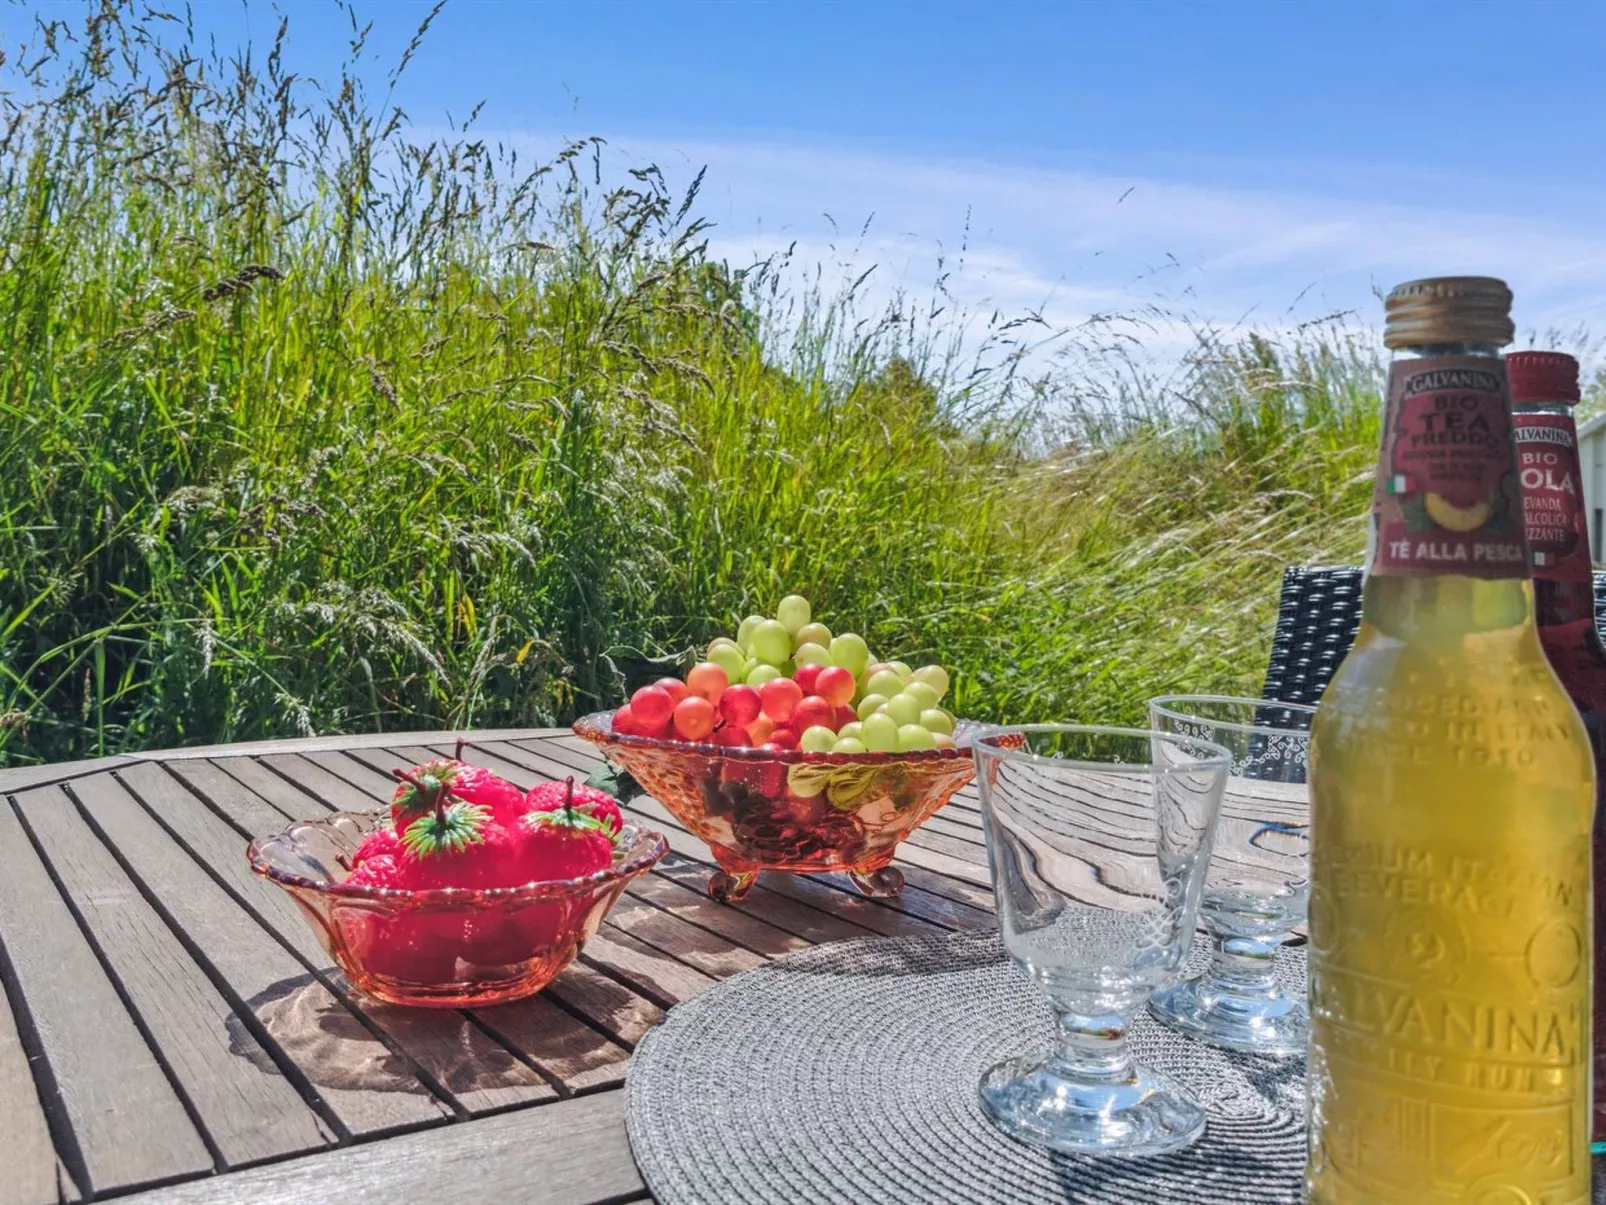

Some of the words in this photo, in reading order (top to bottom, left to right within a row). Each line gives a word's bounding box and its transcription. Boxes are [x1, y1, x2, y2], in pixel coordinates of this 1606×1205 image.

[1411, 370, 1498, 392] GALVANINA
[1435, 395, 1478, 410] BIO
[1419, 412, 1490, 432] TEA
[1411, 432, 1499, 450] FREDDO
[1514, 428, 1572, 446] ALVANINA
[1522, 452, 1559, 465] BIO
[1520, 468, 1575, 494] OLA
[1523, 496, 1562, 511] EVANDA
[1524, 511, 1569, 527] ALCOLICA
[1415, 543, 1468, 561] ALLA
[1473, 544, 1524, 562] PESCA
